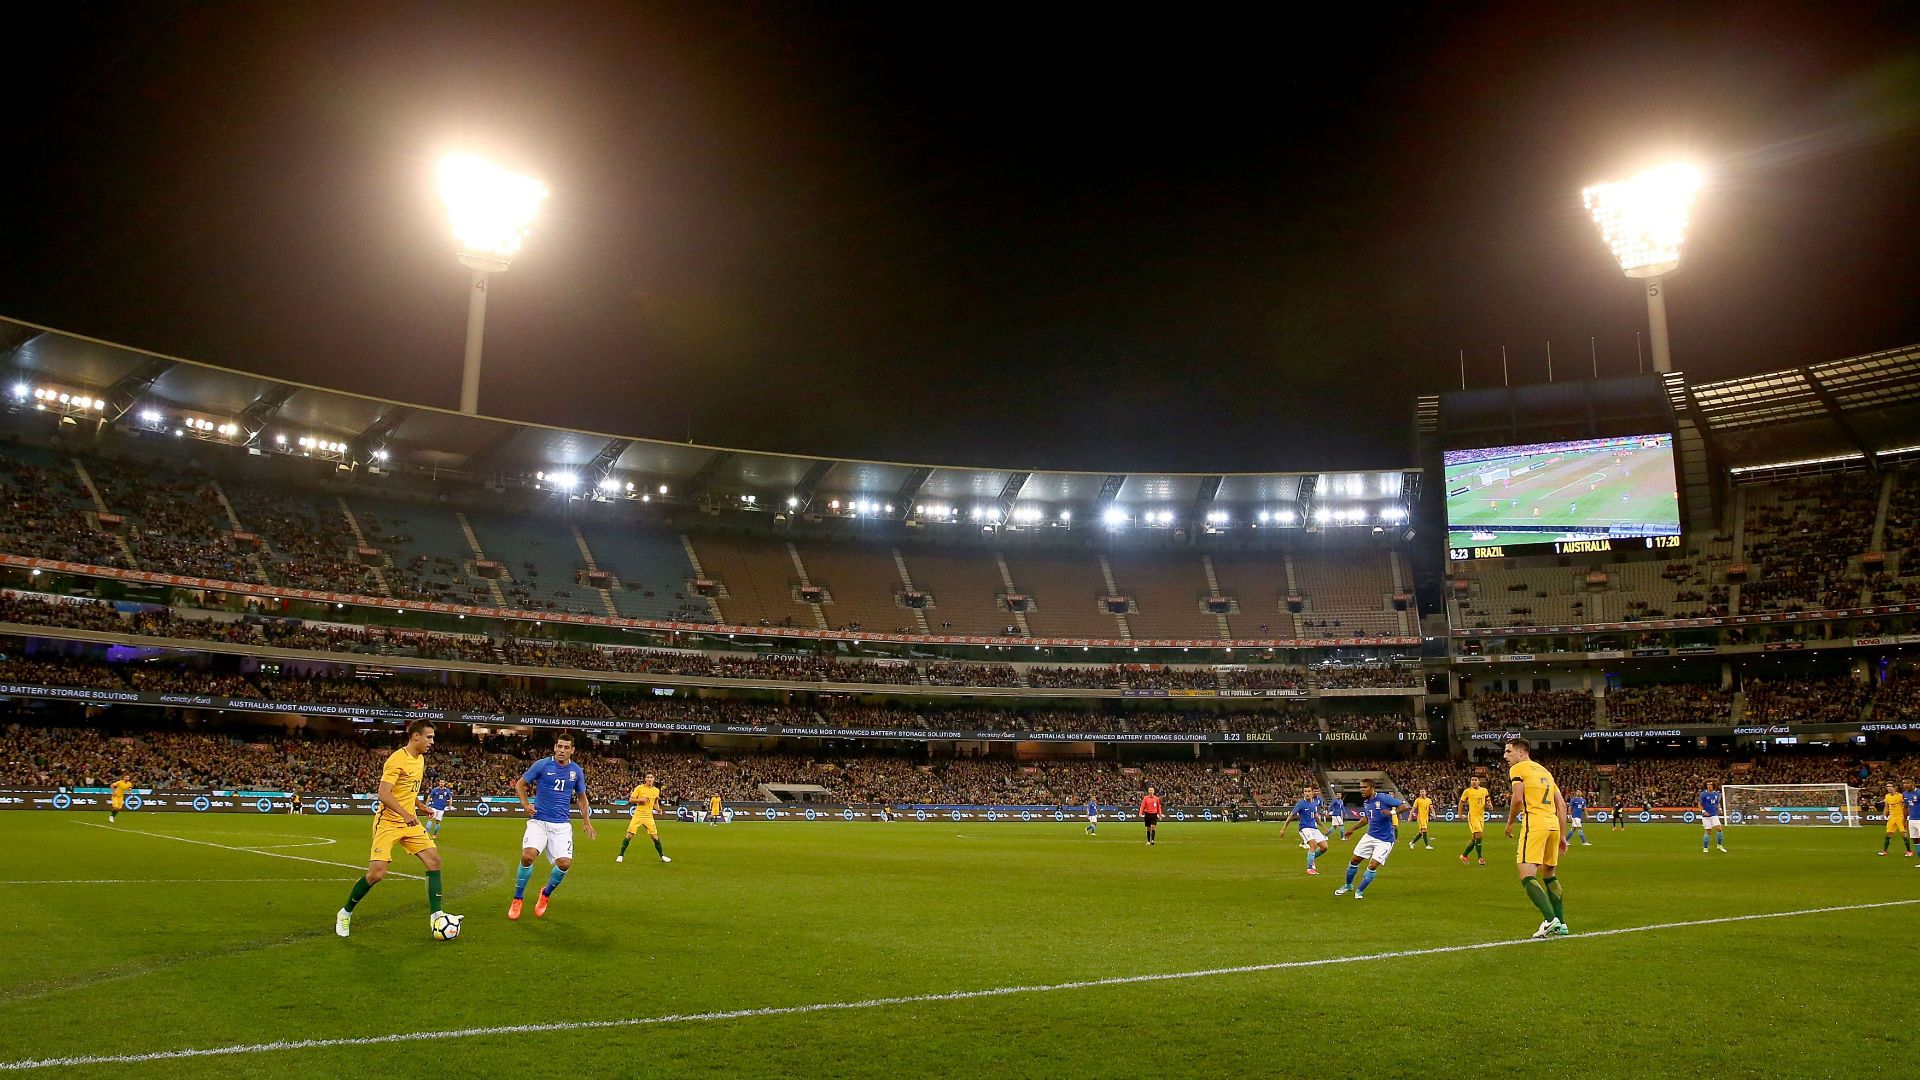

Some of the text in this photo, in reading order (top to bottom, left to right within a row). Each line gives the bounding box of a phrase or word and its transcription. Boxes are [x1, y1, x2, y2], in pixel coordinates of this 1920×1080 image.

[476, 279, 486, 292] 4
[1649, 284, 1658, 296] 5
[1450, 549, 1468, 560] 8:23
[1474, 547, 1504, 558] BRAZIL
[1554, 543, 1560, 553] 1
[1563, 540, 1611, 553] AUSTRALIA
[1655, 536, 1680, 547] 17:20
[10, 686, 48, 695] BATTERY
[51, 688, 90, 698] STORAGE
[92, 692, 138, 701] SOLUTIONS
[229, 700, 274, 710] AUSTRALIAS
[298, 705, 337, 713] ADVANCED
[338, 707, 370, 715] BATTERY
[405, 711, 444, 719] SOLUTIONS
[520, 717, 560, 725] AUSTRALIAS
[553, 779, 565, 791] 21
[1541, 777, 1551, 804] 2
